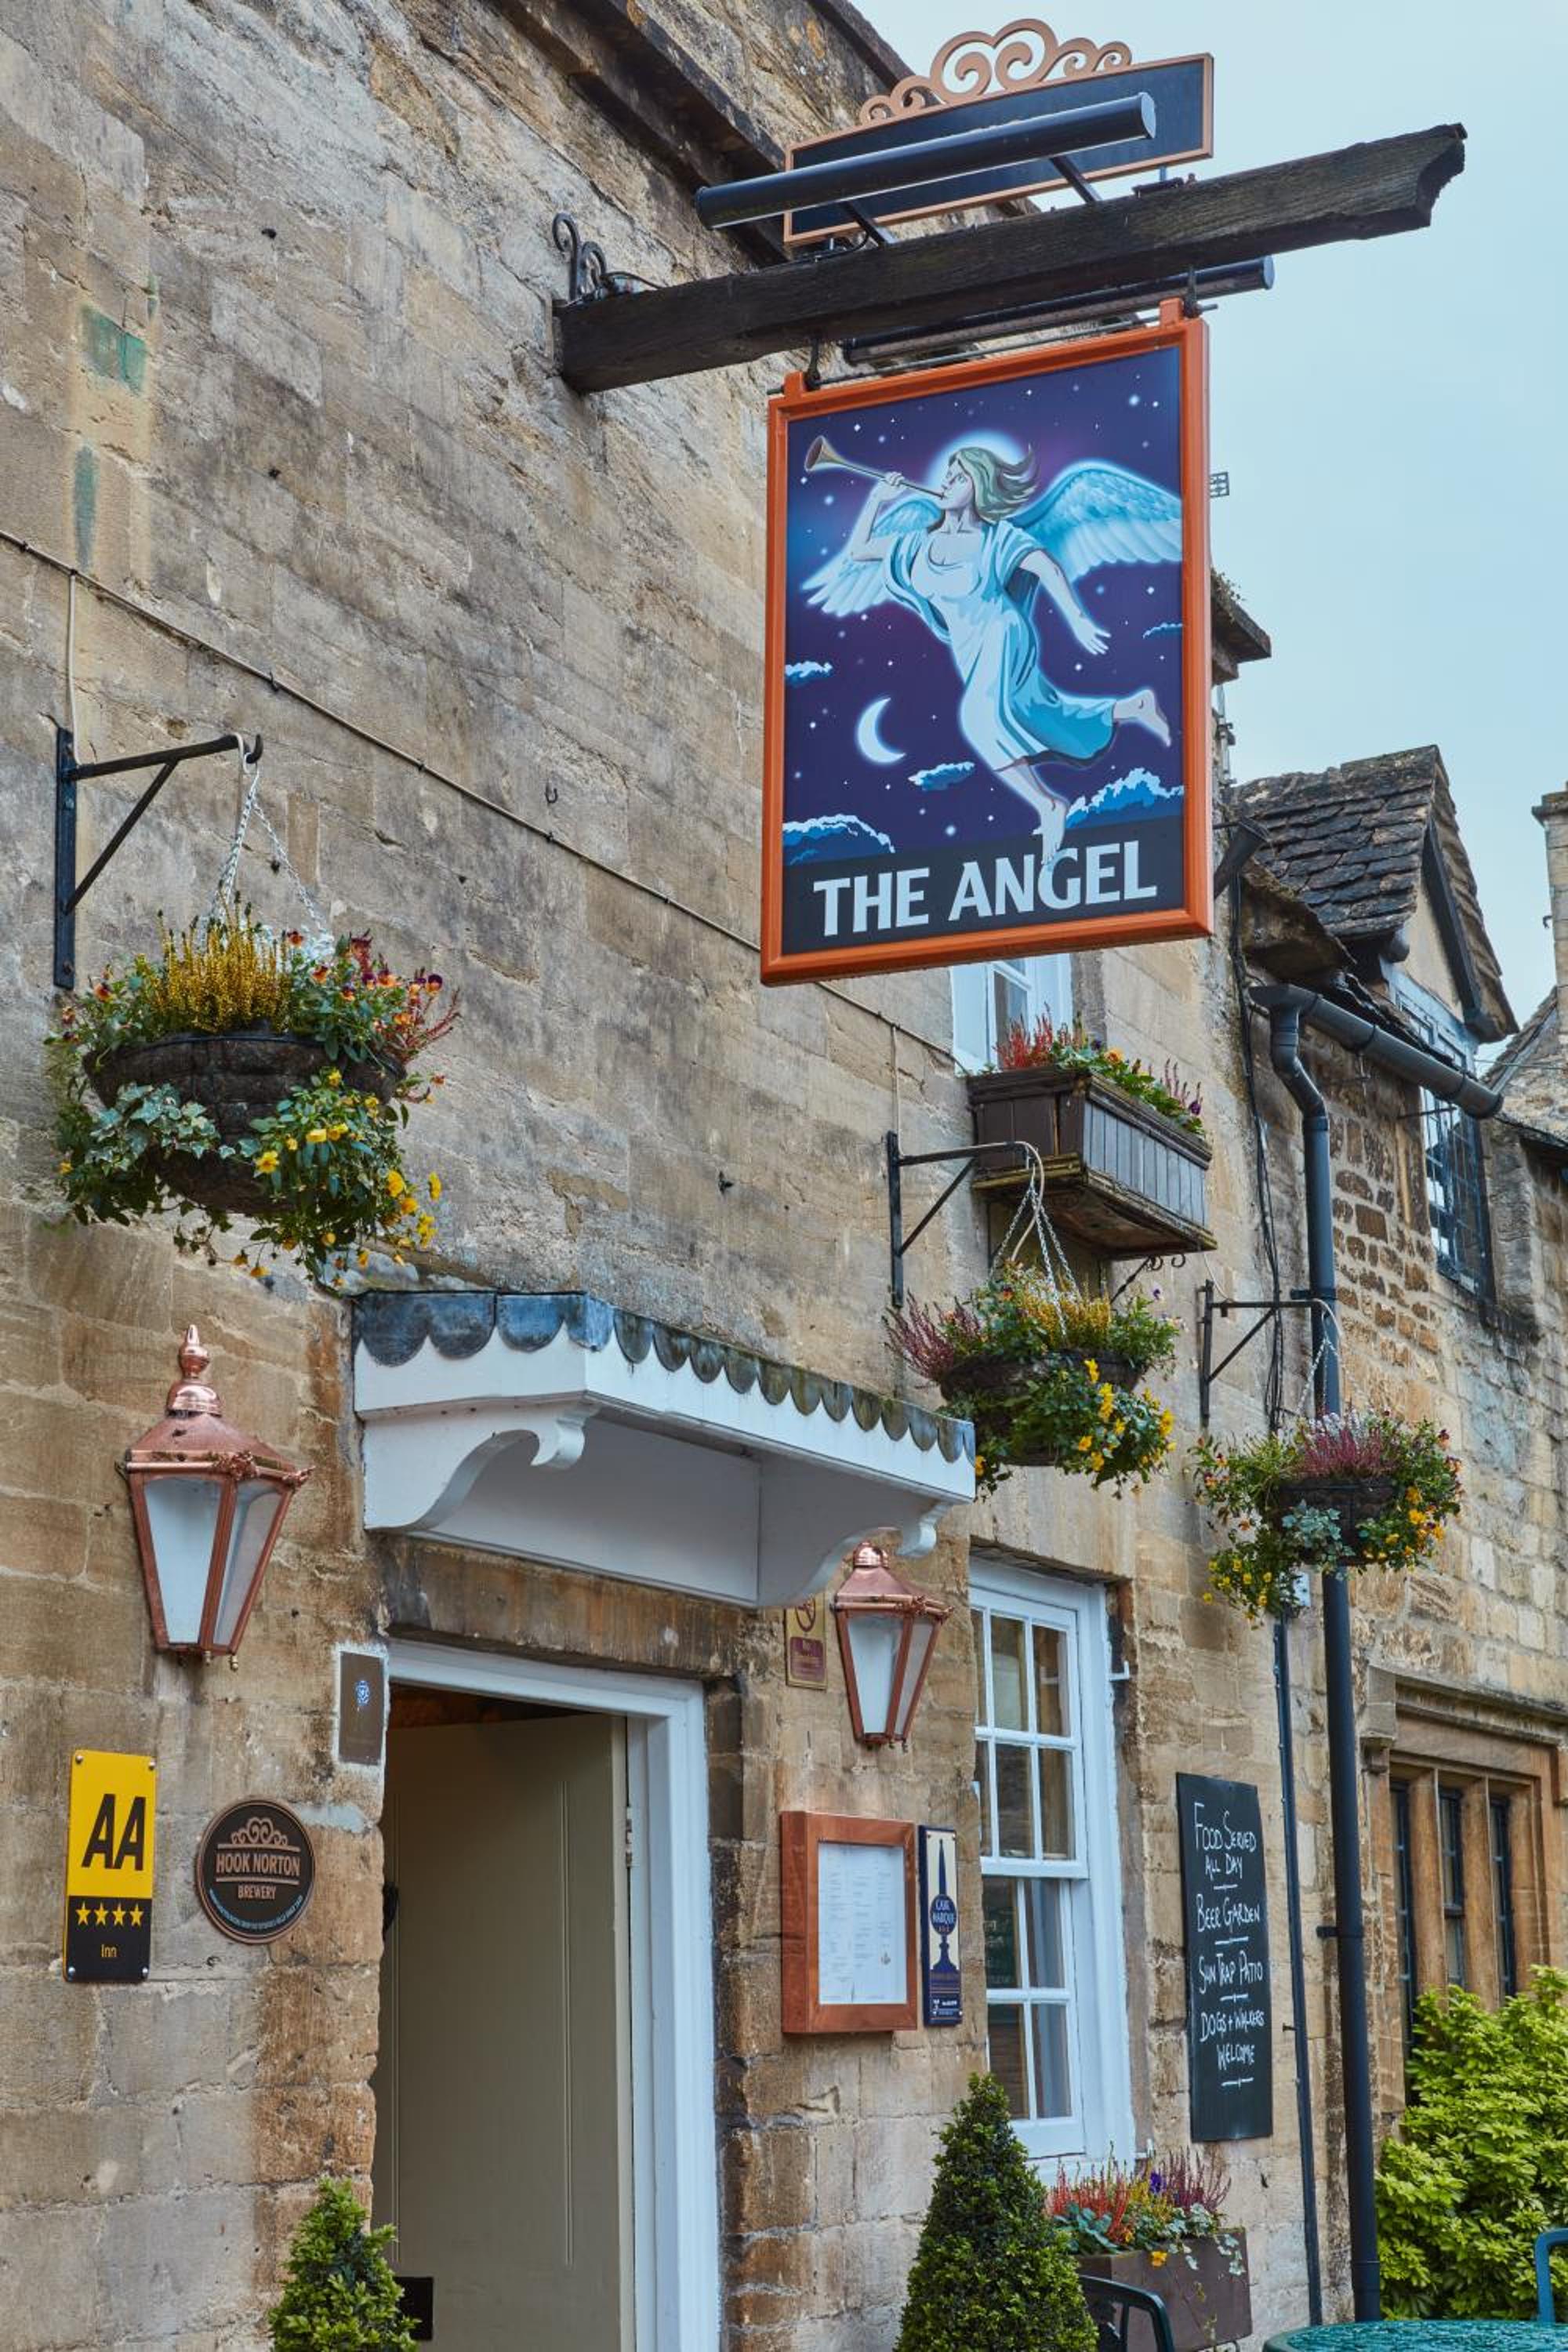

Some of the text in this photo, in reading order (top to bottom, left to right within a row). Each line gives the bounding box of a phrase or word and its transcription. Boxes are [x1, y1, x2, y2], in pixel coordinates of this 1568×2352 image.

[813, 840, 1158, 937] THE ANGEL
[81, 1793, 146, 1871] AA
[1194, 1801, 1257, 1853] FOOD SERVED
[216, 1853, 300, 1876] HOOK NORTON
[1205, 1853, 1243, 1881] ALL DAY
[238, 1885, 277, 1900] BREWERY
[1196, 1893, 1260, 1933] BEER GARDEN
[101, 1944, 117, 1958] Inn
[1199, 1950, 1263, 1994] SUN TRAP PATIO
[1200, 2011, 1226, 2042] DOGS
[1233, 2008, 1265, 2032] WALKERS
[1216, 2042, 1255, 2071] WELCOME
